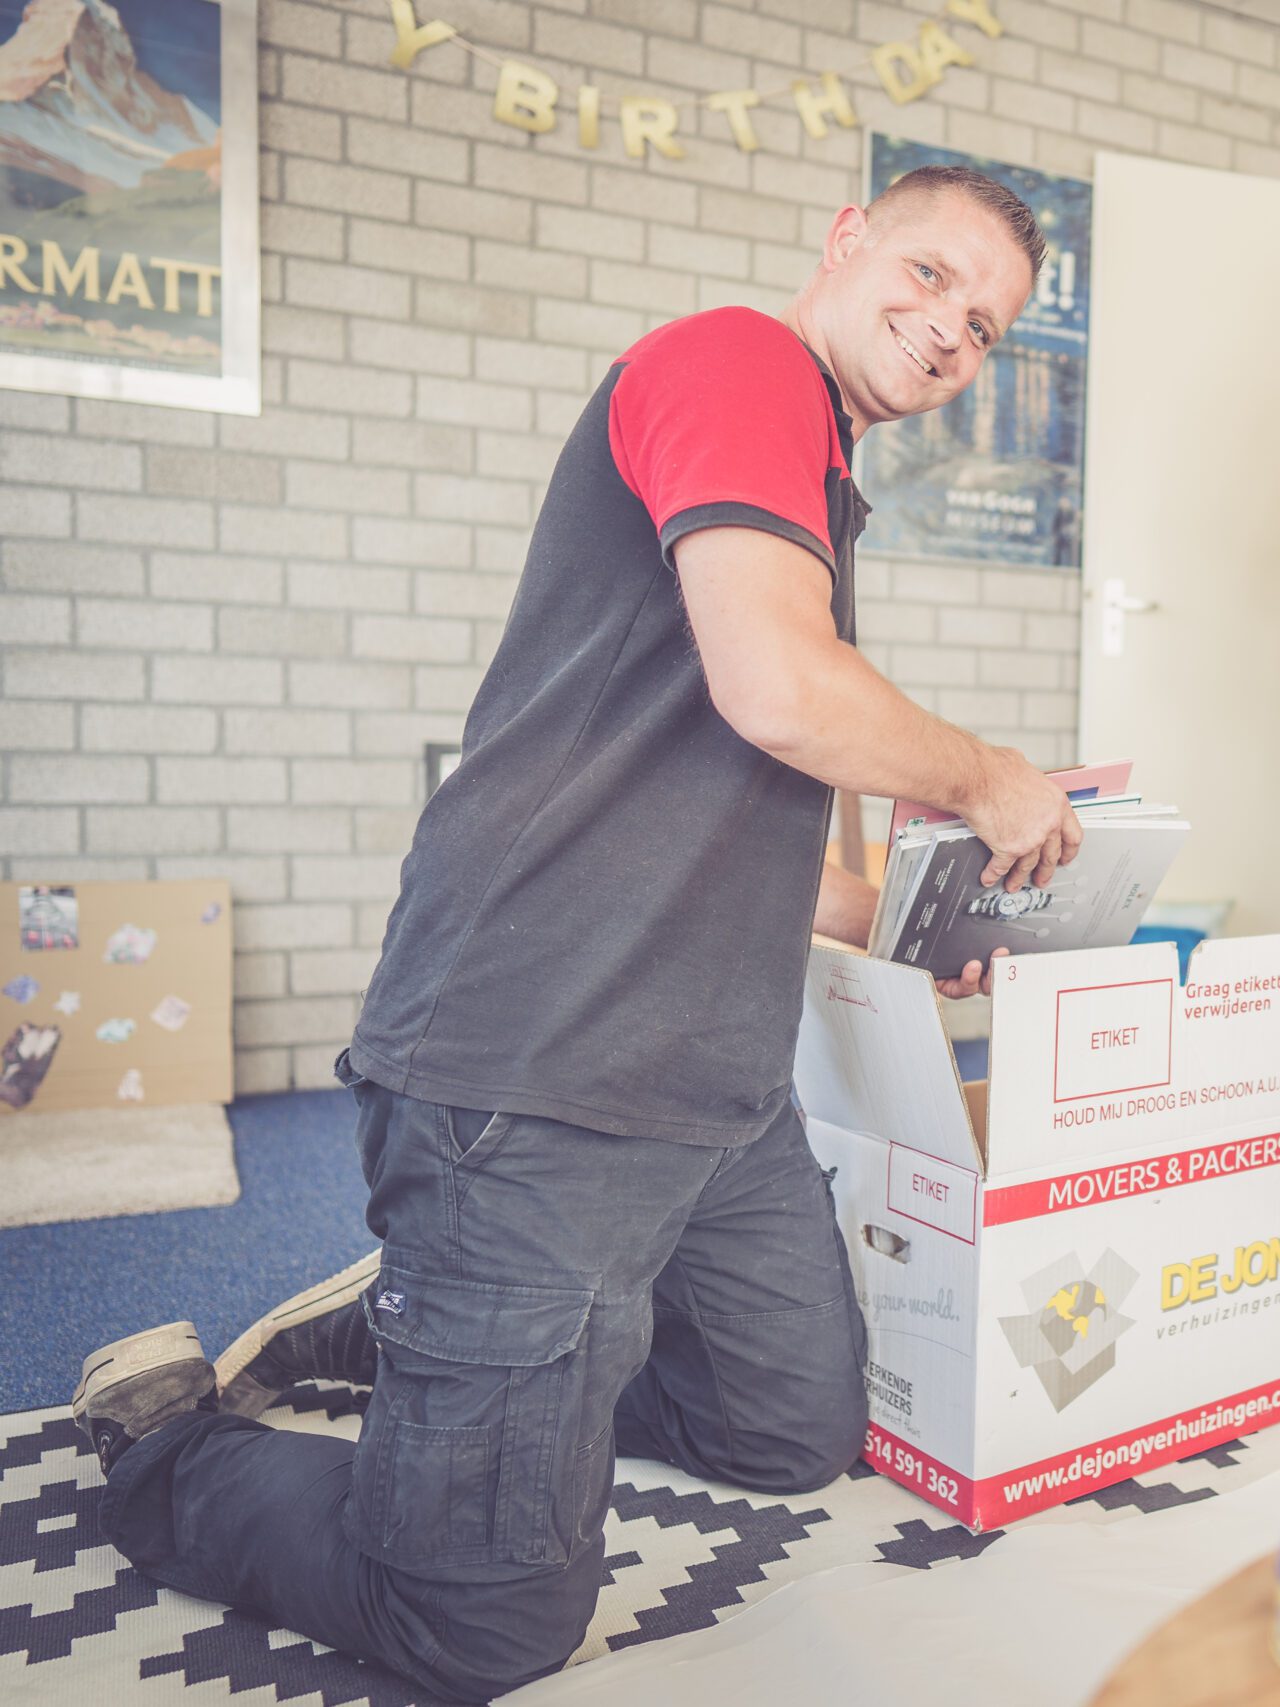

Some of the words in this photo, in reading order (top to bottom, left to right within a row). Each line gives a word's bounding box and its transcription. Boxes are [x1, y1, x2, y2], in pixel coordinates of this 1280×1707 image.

[1008, 966, 1017, 981] 3
[1186, 982, 1230, 1000] Graag
[1184, 997, 1271, 1019] verwijderen
[1091, 1027, 1139, 1050] ETIKET
[1053, 1106, 1096, 1129] HOUD
[1099, 1103, 1123, 1121] MIJ
[1127, 1094, 1175, 1116] DROOG
[1180, 1089, 1197, 1107] EN
[1200, 1080, 1254, 1104] SCHOON
[912, 1173, 950, 1203] ETIKET
[1048, 1161, 1160, 1210] MOVERS
[1164, 1158, 1183, 1184] &
[1160, 1253, 1218, 1312] DE
[865, 1377, 912, 1416] RHUIZERS
[869, 1360, 913, 1398] ERKENDE
[895, 1448, 923, 1484] 591
[927, 1467, 959, 1506] 362
